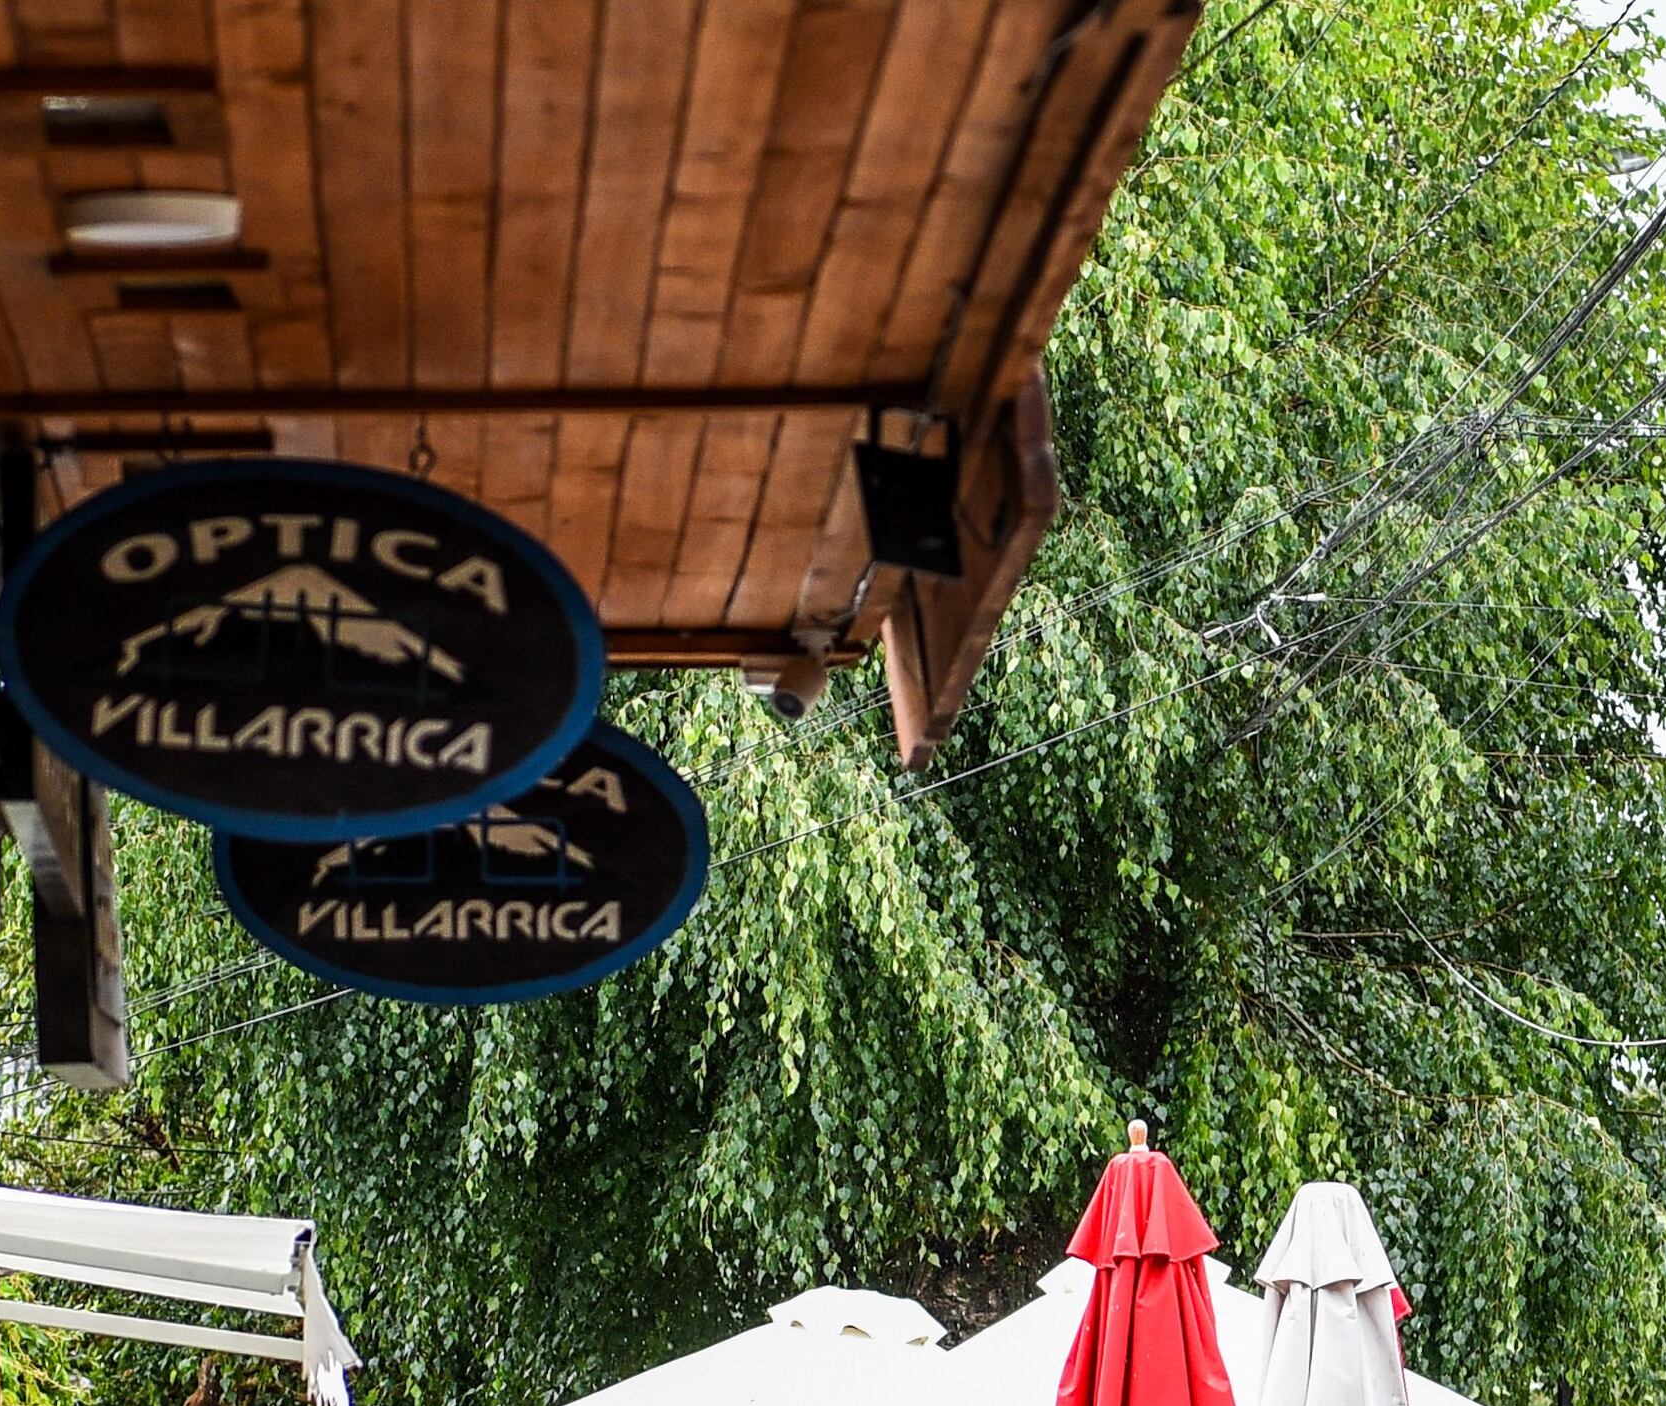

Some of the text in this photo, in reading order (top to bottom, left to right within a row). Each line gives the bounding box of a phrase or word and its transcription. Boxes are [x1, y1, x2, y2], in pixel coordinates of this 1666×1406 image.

[101, 514, 510, 616] OPTICA
[90, 693, 496, 773] VILLARRICA
[296, 898, 621, 943] VILLARRICA
